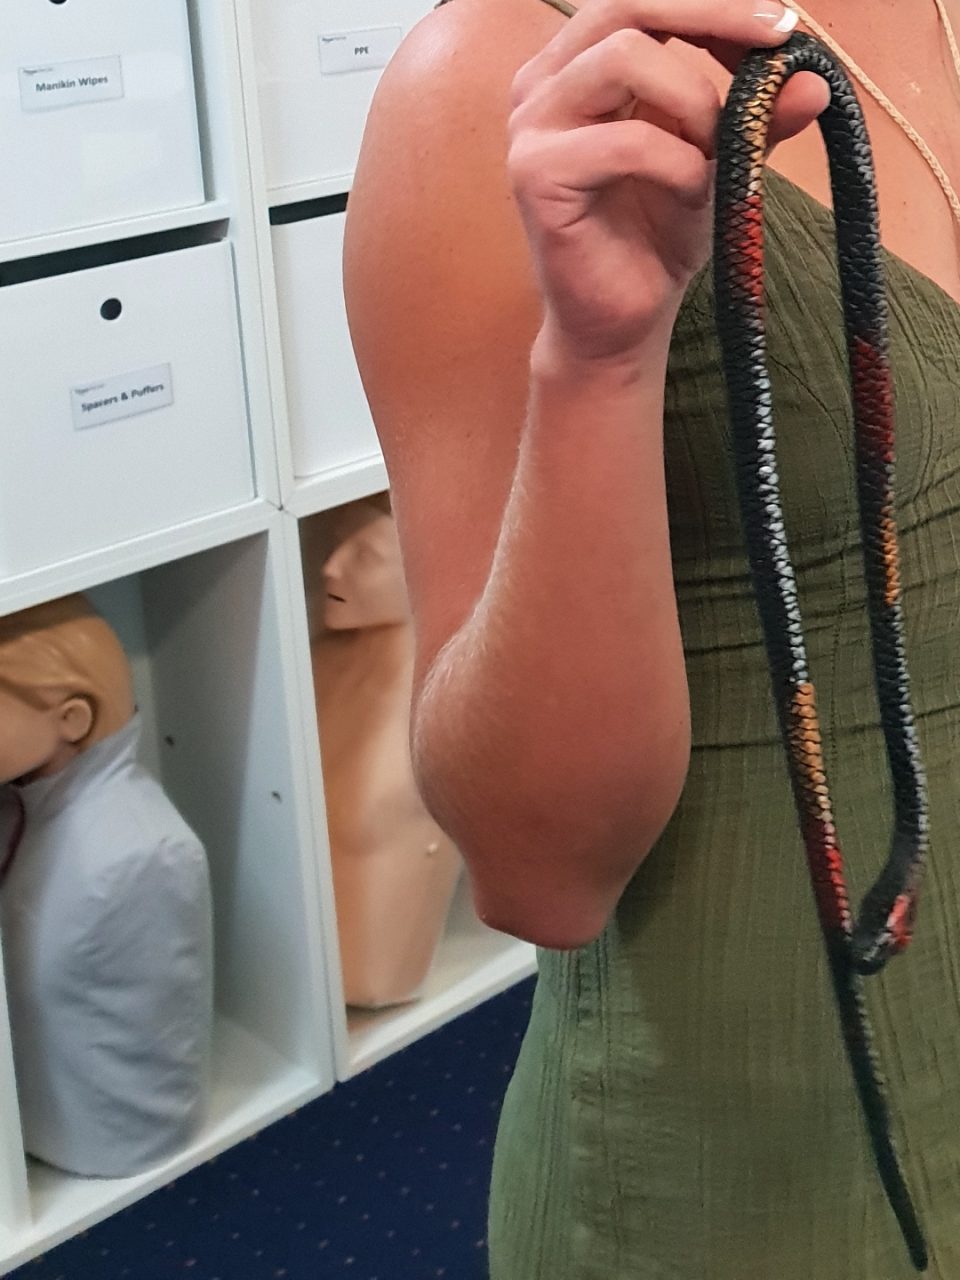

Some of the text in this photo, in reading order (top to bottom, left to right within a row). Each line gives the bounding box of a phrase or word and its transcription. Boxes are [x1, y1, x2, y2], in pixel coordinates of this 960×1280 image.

[354, 46, 369, 55] PPE
[35, 76, 108, 92] Manikin Wipes
[120, 391, 129, 401] &
[130, 384, 164, 399] Puffers
